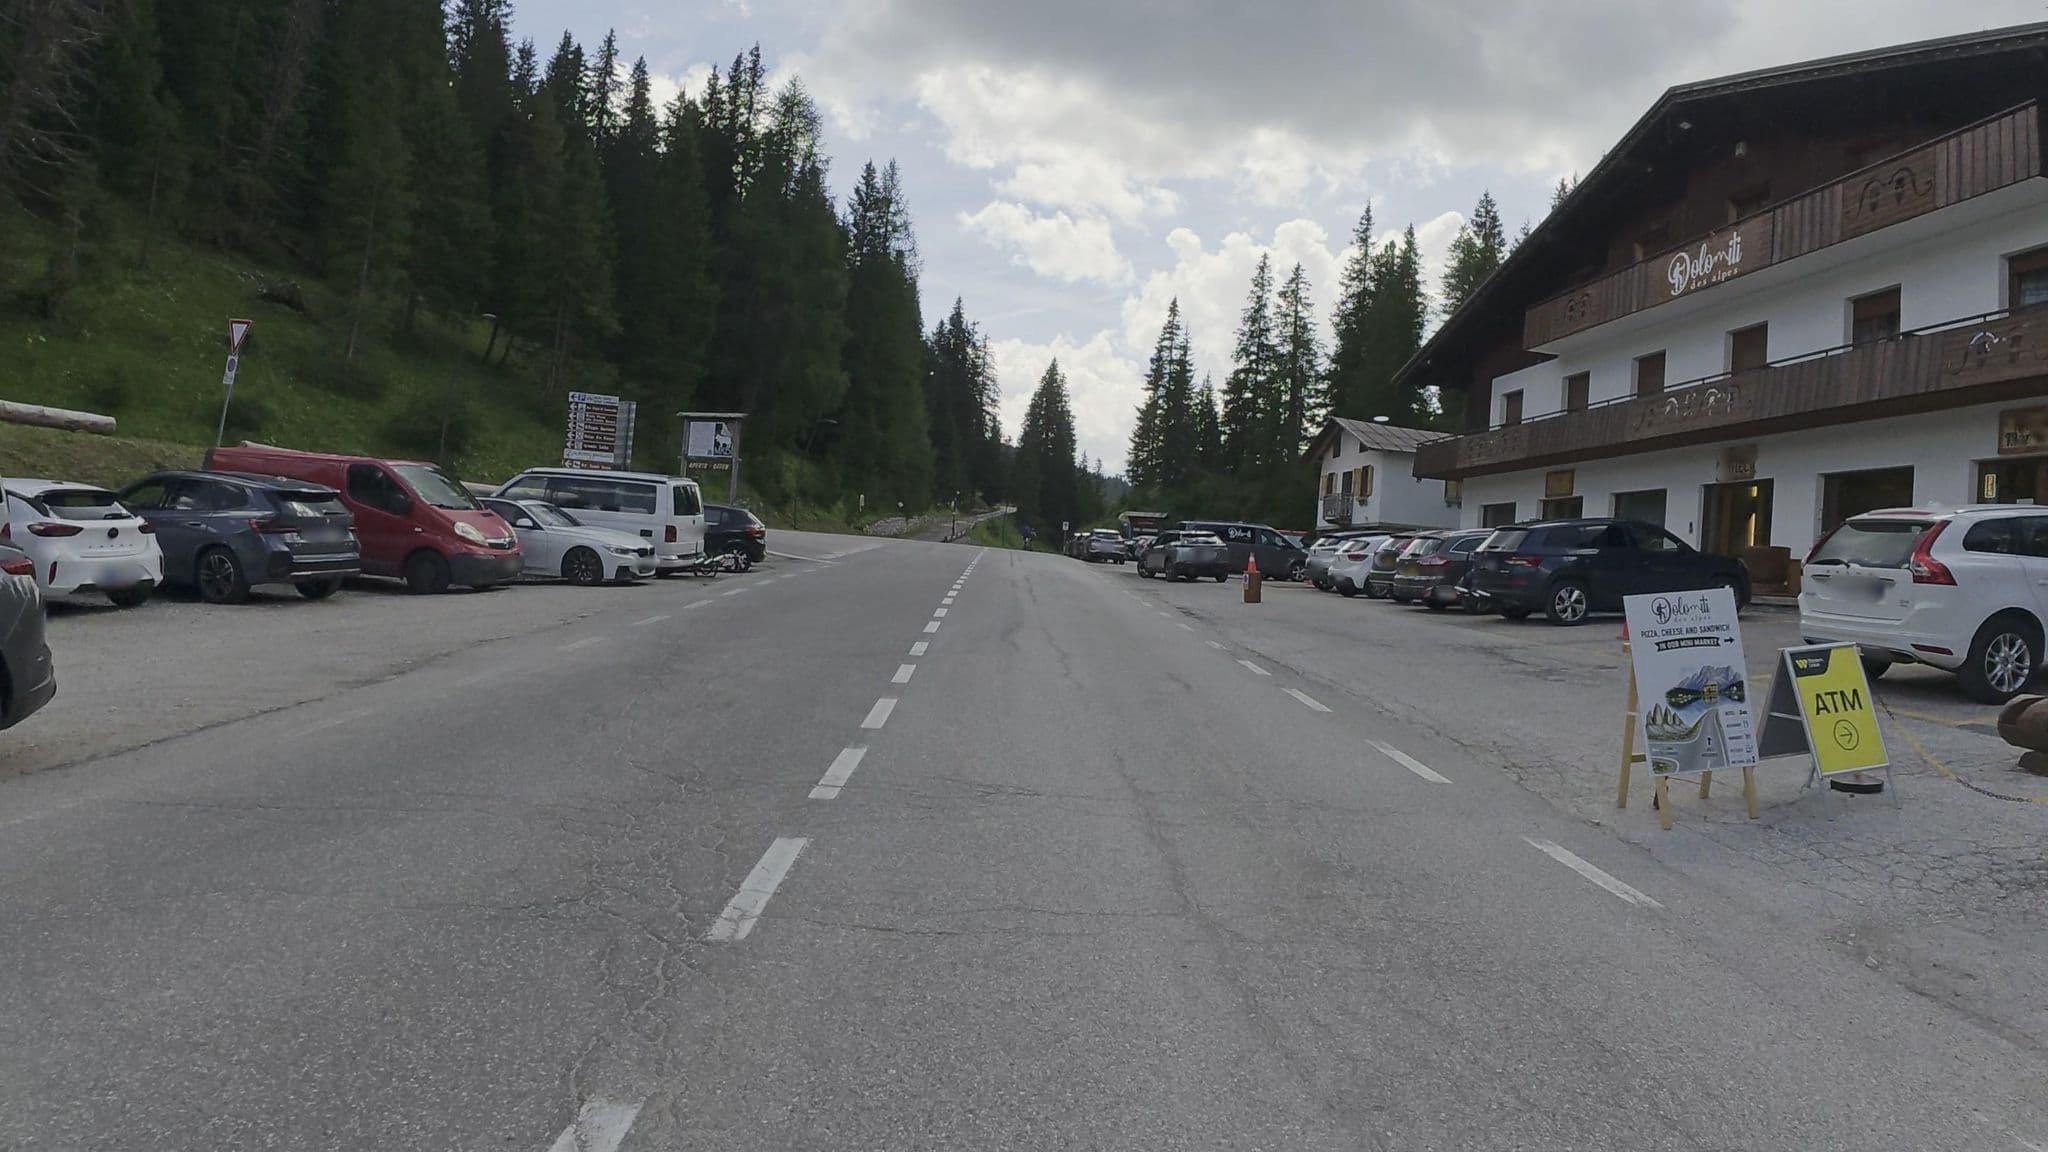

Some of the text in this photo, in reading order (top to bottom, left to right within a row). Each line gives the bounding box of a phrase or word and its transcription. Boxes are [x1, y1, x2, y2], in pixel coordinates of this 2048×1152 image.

[1668, 232, 1742, 295] Dolomiti
[1690, 267, 1738, 290] des alpes
[1651, 595, 1710, 624] Dolomiti
[1641, 624, 1730, 638] PIZZA, CHEESE AND SANDWICH
[1667, 640, 1680, 648] OUR
[1680, 639, 1693, 647] MINI
[1694, 638, 1717, 647] MARKET
[1815, 688, 1863, 715] ATM
